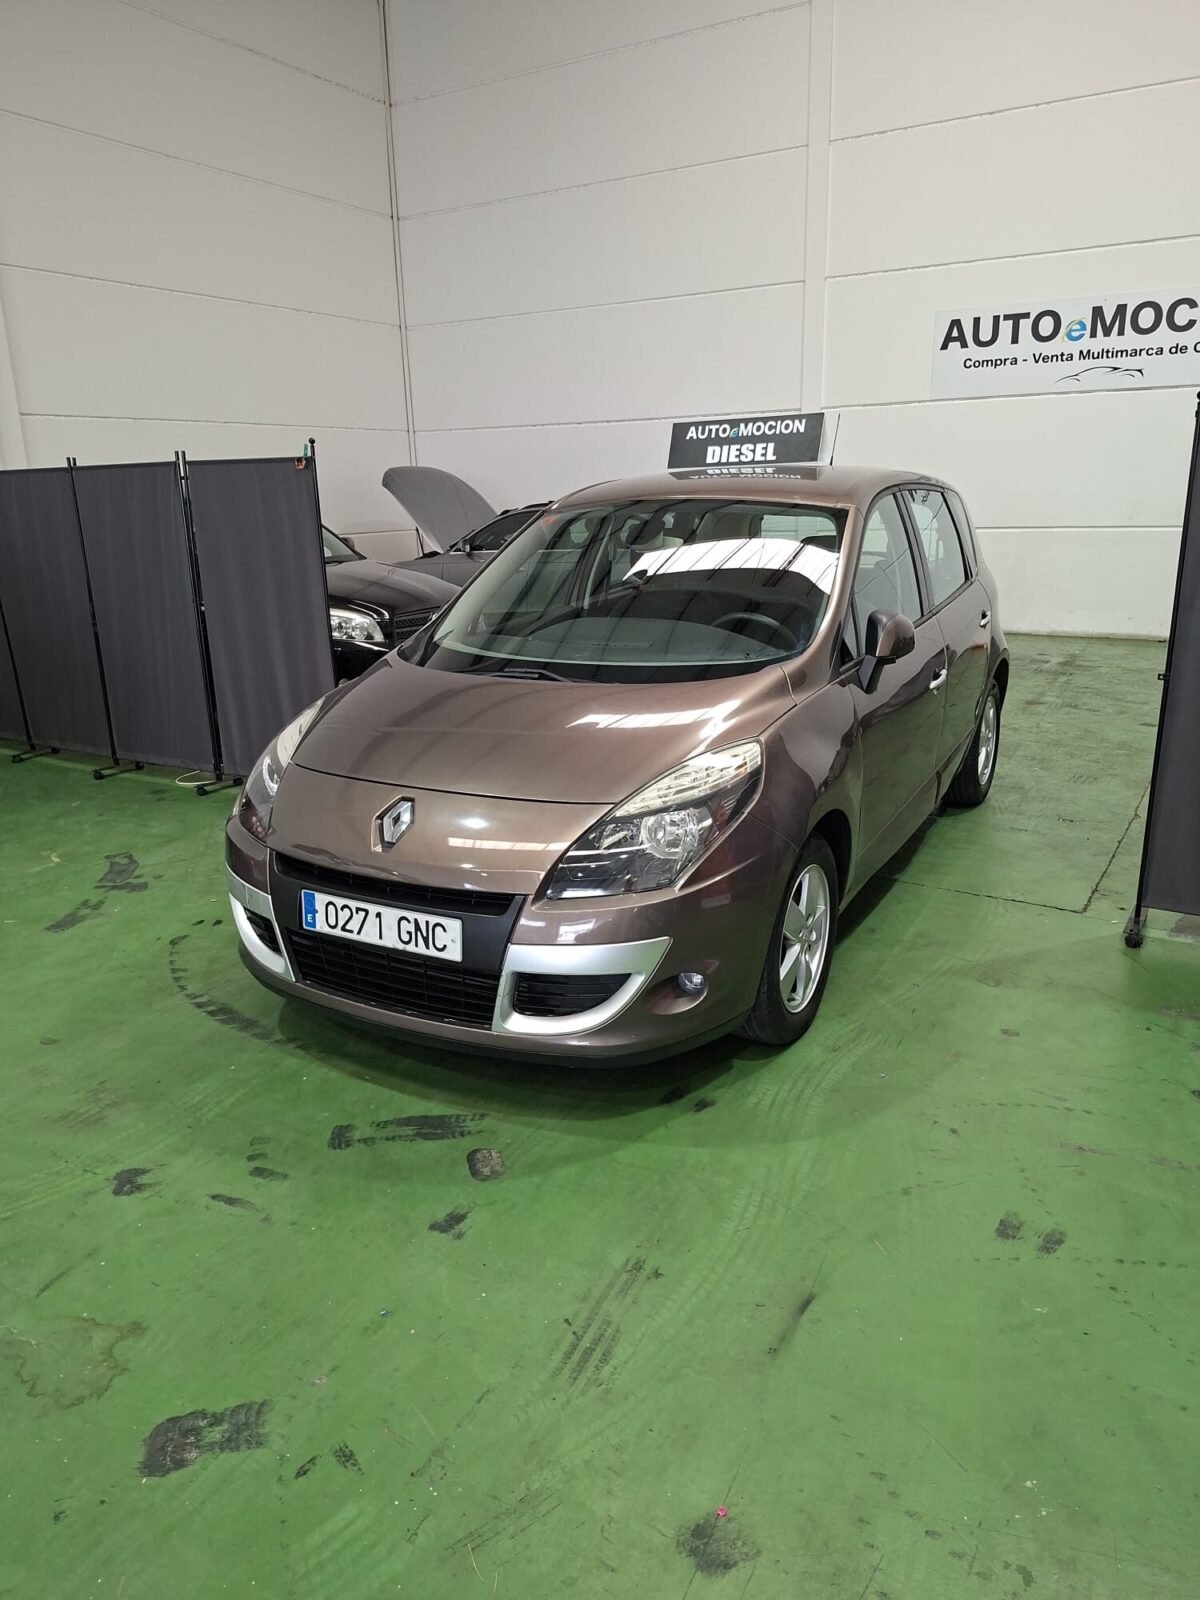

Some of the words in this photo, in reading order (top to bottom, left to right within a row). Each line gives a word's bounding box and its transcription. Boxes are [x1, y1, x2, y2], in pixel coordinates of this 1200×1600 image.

[963, 357, 1018, 369] Compra
[1033, 352, 1074, 364] Venta
[1078, 345, 1164, 361] Multimarca
[1169, 343, 1188, 355] de
[706, 443, 776, 464] DIESEL
[307, 914, 313, 923] E
[325, 901, 383, 940] 0271
[397, 916, 447, 952] GNC
